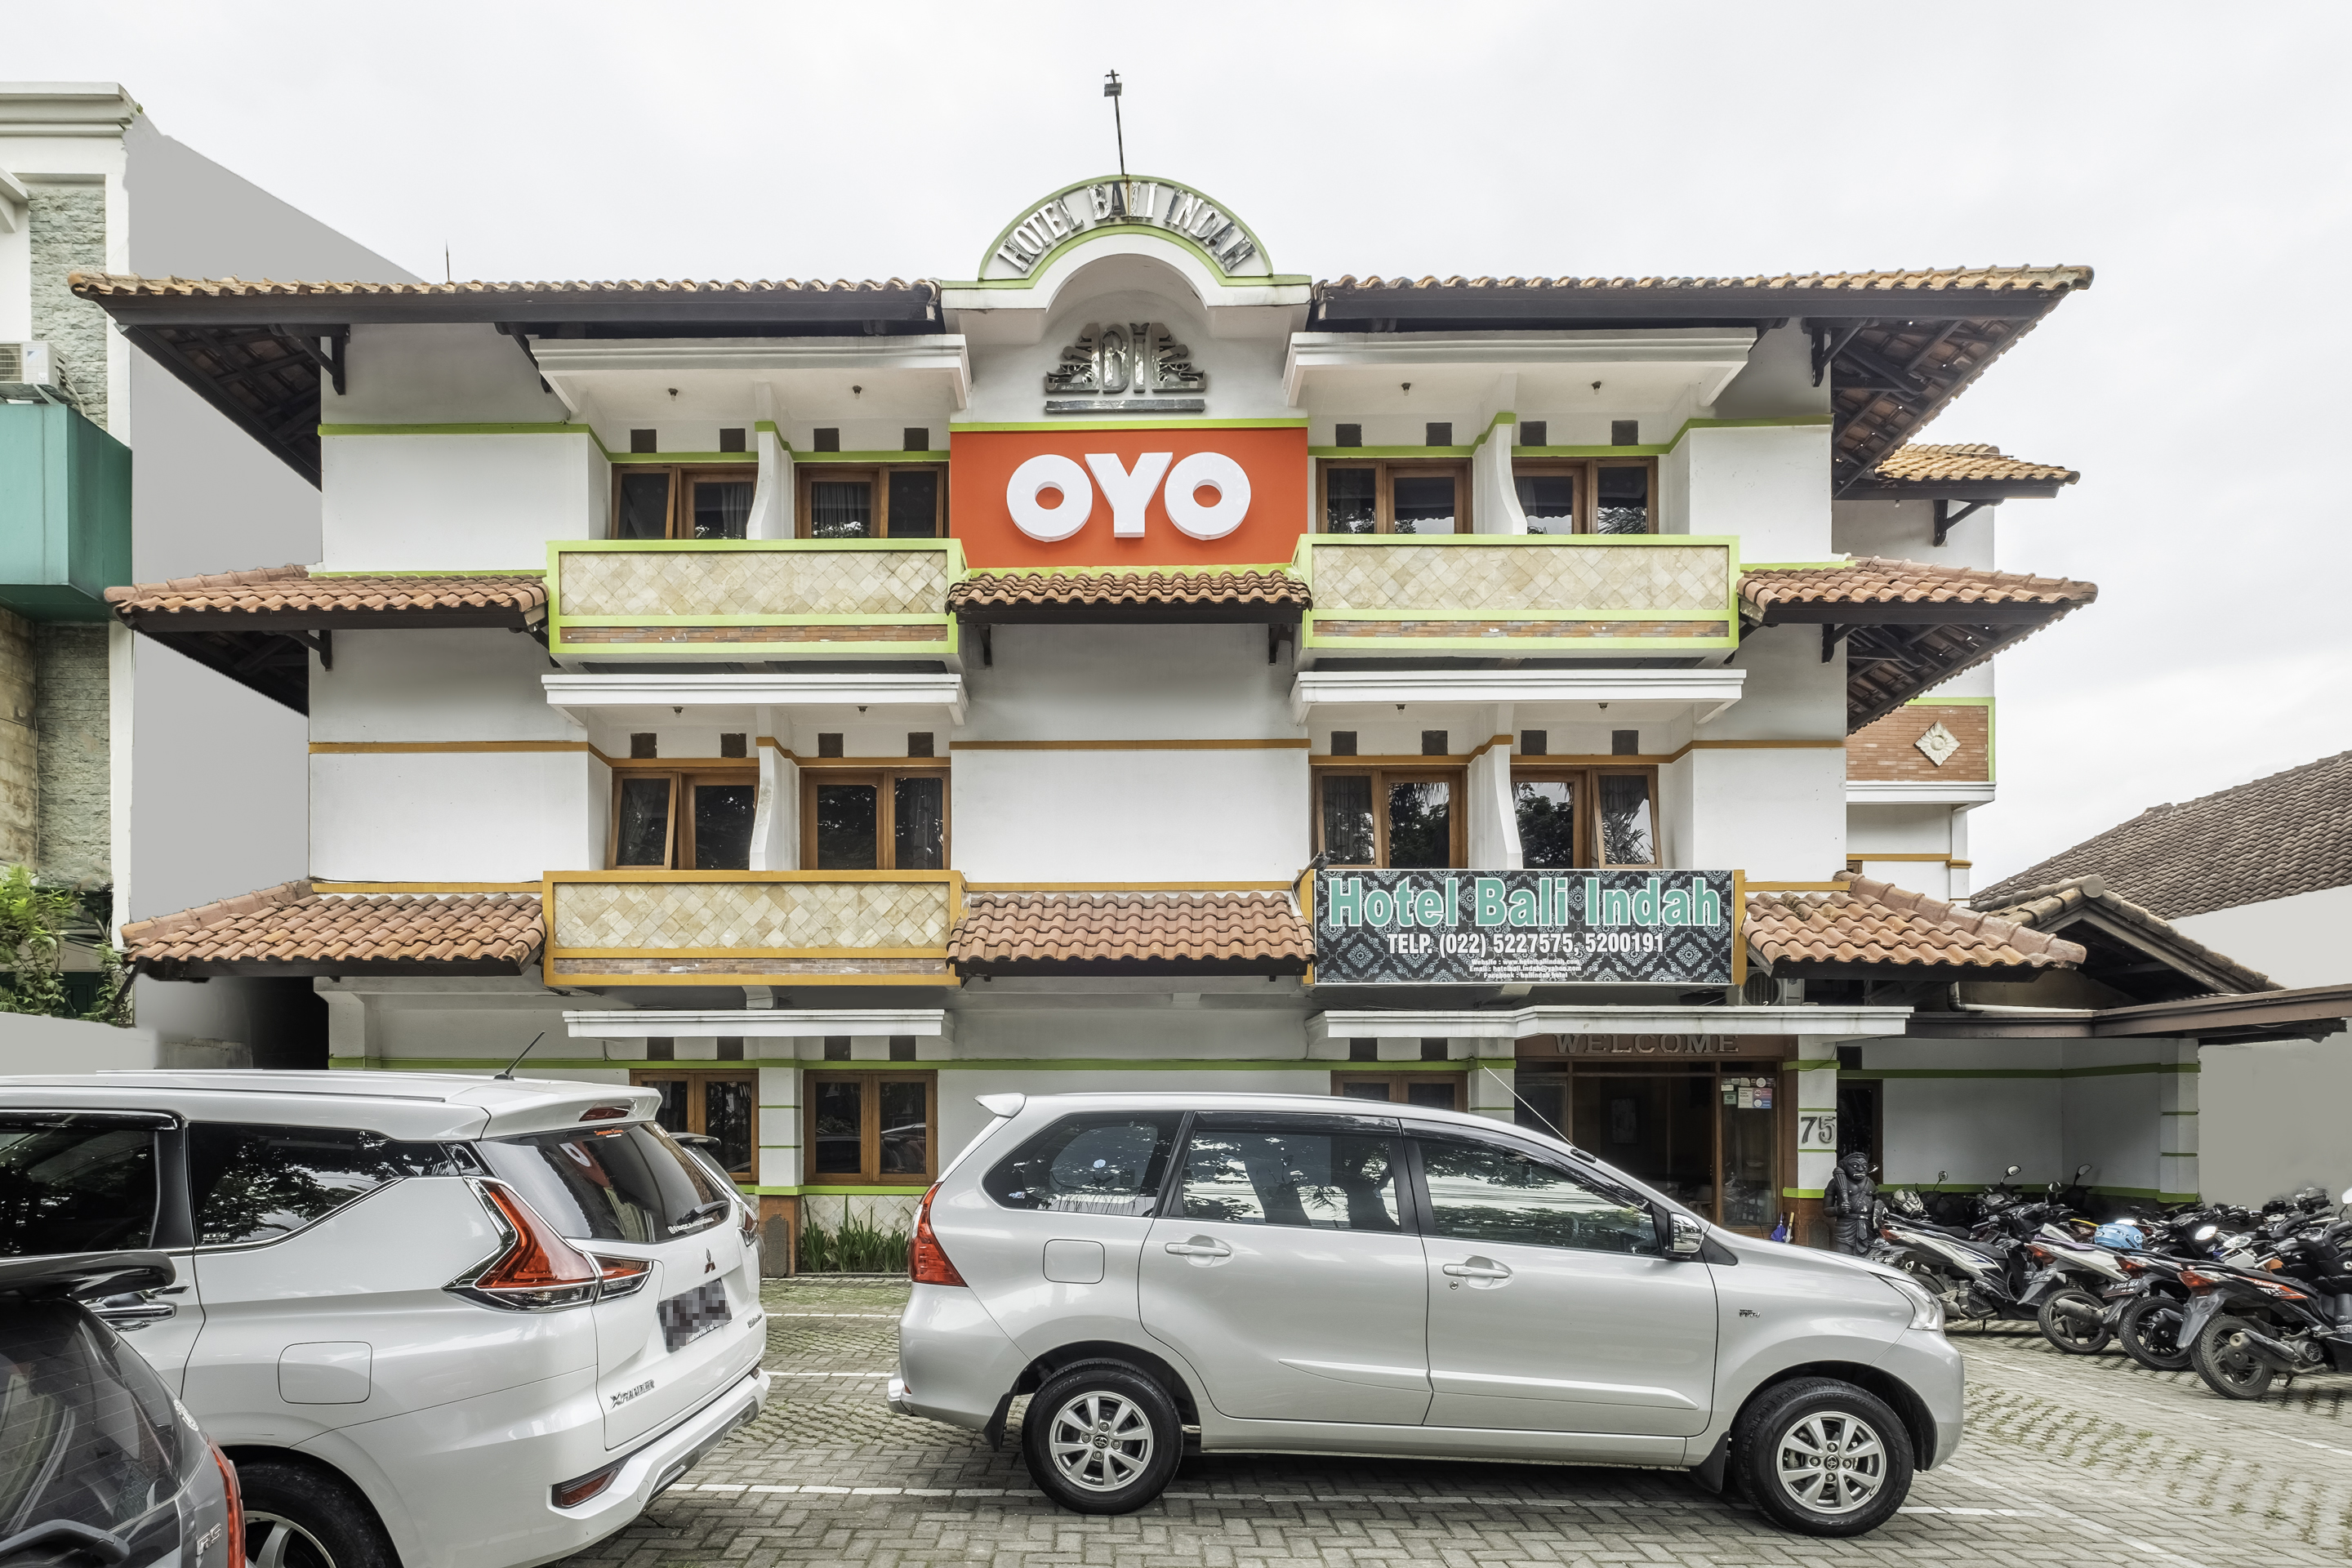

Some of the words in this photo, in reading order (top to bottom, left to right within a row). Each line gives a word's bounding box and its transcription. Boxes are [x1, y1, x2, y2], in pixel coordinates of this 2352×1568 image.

[997, 197, 1085, 274] HOTEL
[1087, 180, 1158, 221] BALI
[1163, 187, 1256, 272] INDAH
[1006, 452, 1252, 542] OYO
[1328, 876, 1459, 928] Hotel
[1475, 877, 1569, 928] Bali
[1585, 876, 1722, 928] Indah
[1387, 933, 1432, 954] TELP.
[1440, 933, 1486, 958] (022)
[1494, 933, 1579, 956] 5227575,
[1586, 933, 1664, 954] 5200191
[1554, 1034, 1740, 1054] WELCOME
[1801, 1116, 1837, 1143] 75
[196, 1522, 222, 1556] RS
